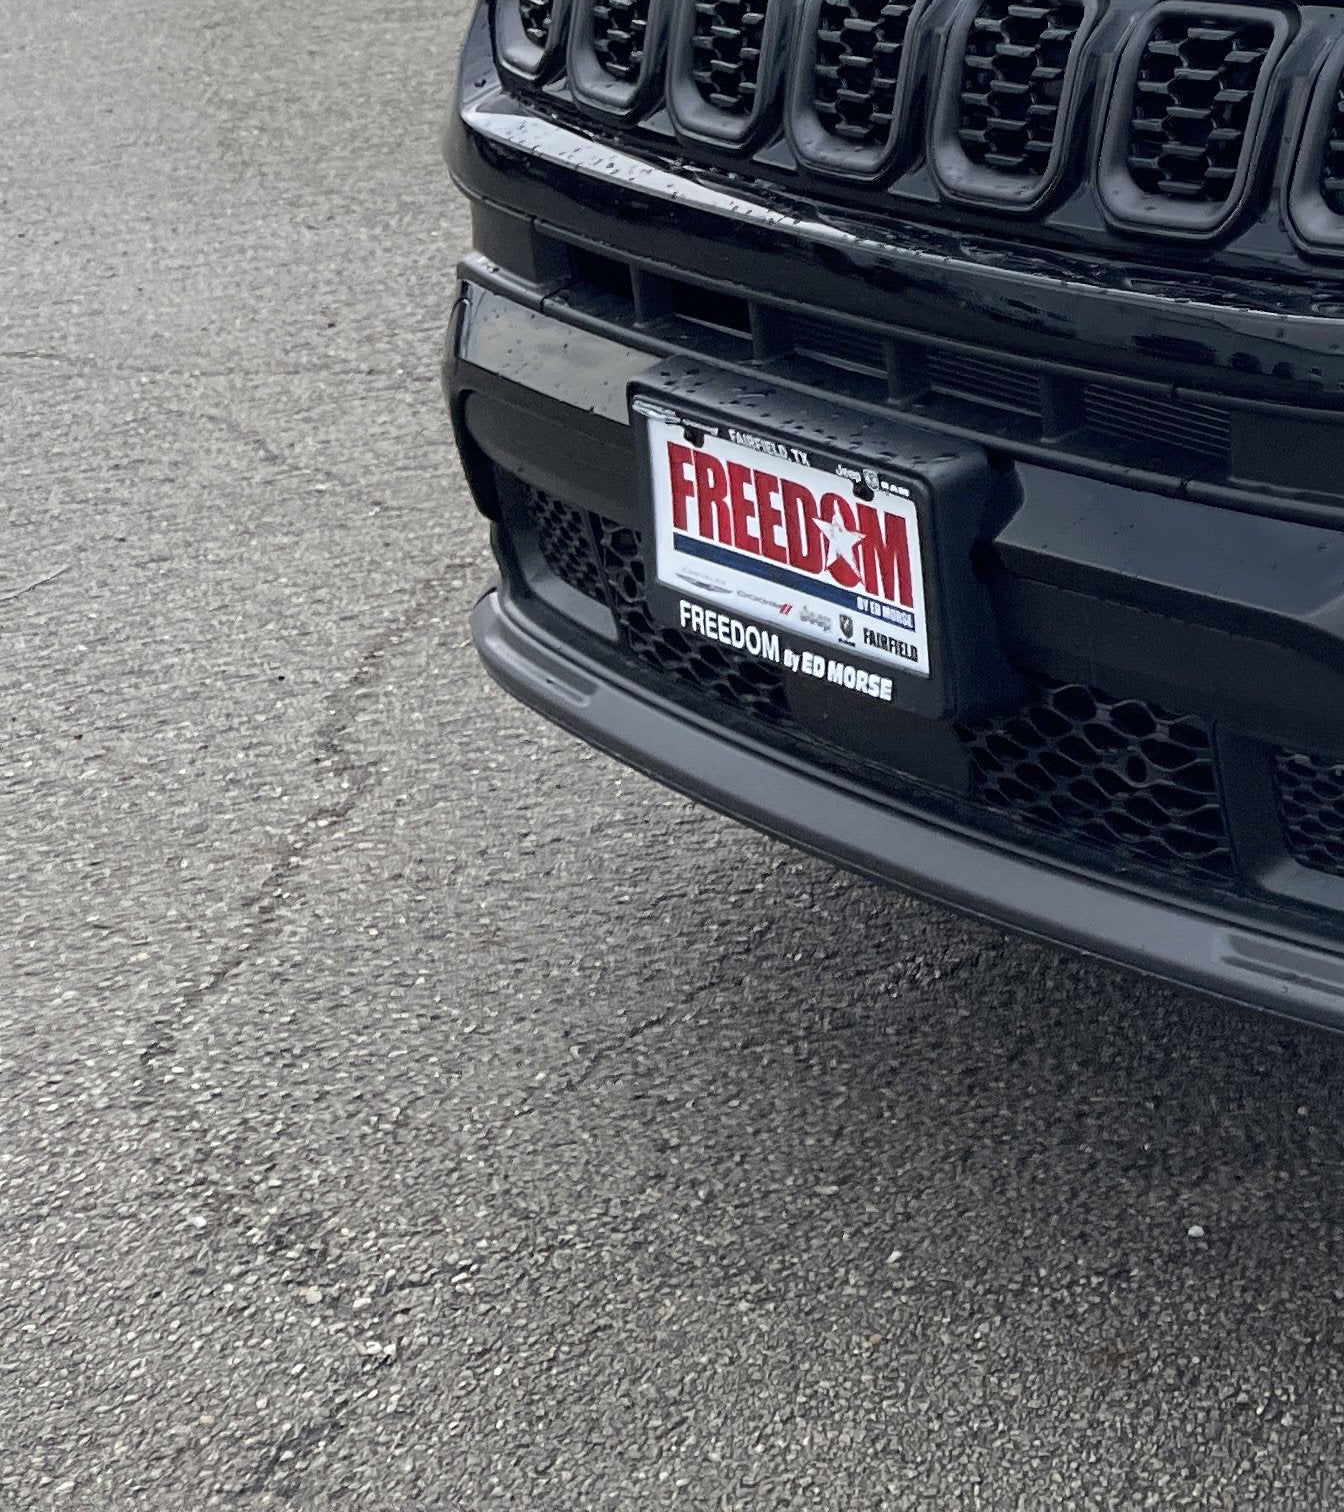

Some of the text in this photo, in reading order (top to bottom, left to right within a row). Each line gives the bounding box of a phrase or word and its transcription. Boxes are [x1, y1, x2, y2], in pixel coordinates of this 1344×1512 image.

[666, 440, 915, 609] FREEDOM
[870, 600, 881, 617] ED
[680, 599, 780, 663] FREEDOM
[801, 651, 826, 679] ED
[827, 659, 893, 702] MORSE
[863, 627, 919, 663] FAIRFIELD
